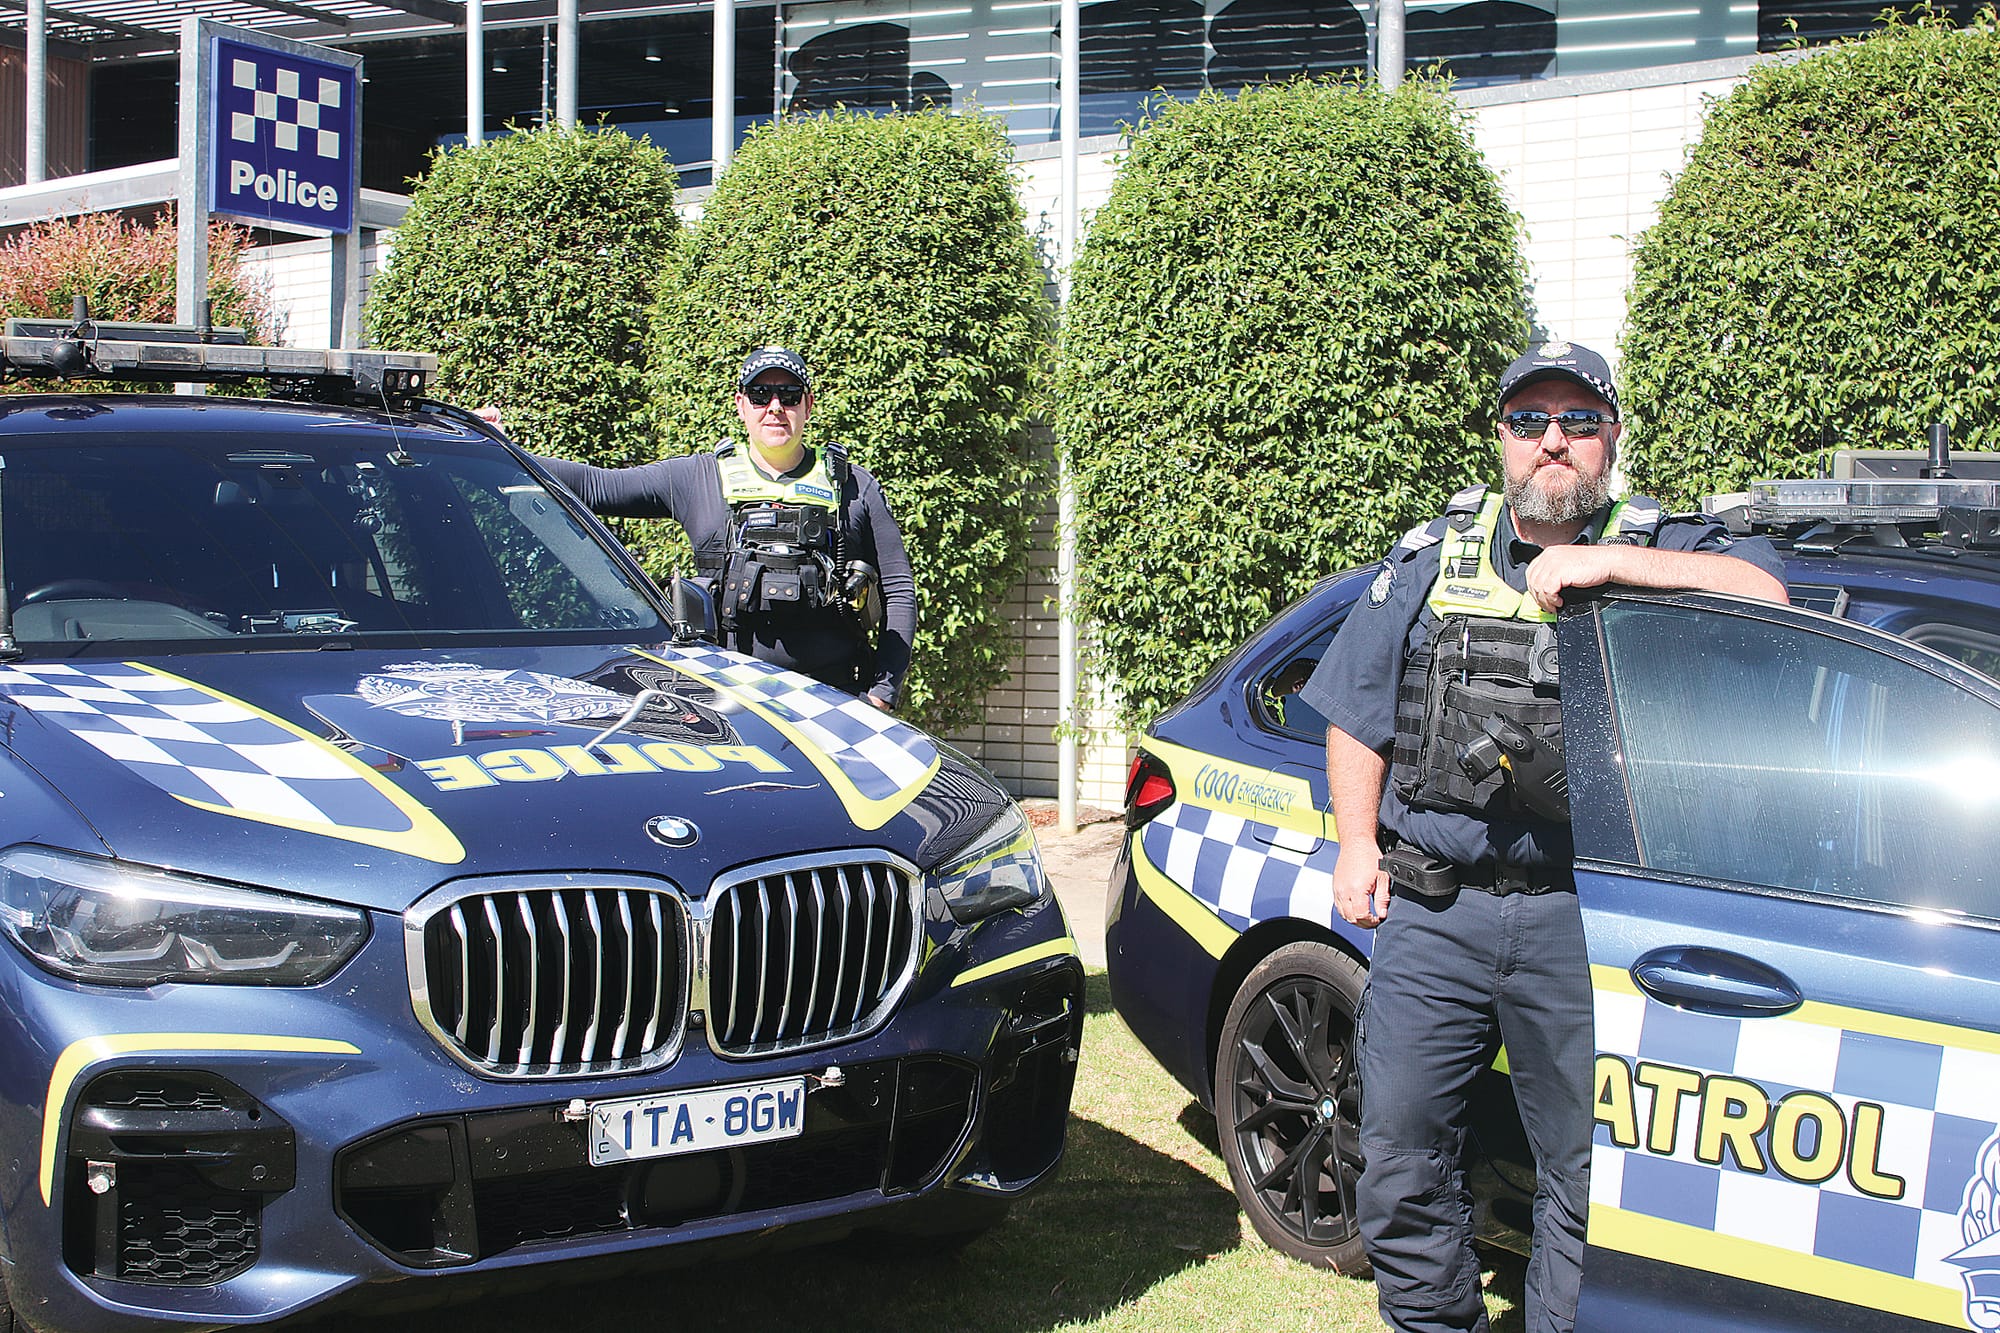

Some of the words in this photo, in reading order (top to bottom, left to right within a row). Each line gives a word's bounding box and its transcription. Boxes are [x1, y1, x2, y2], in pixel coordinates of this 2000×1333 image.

[230, 159, 338, 211] Police
[798, 485, 830, 498] Police
[1238, 781, 1296, 814] EMERGENCY
[598, 1111, 612, 1155] VIC
